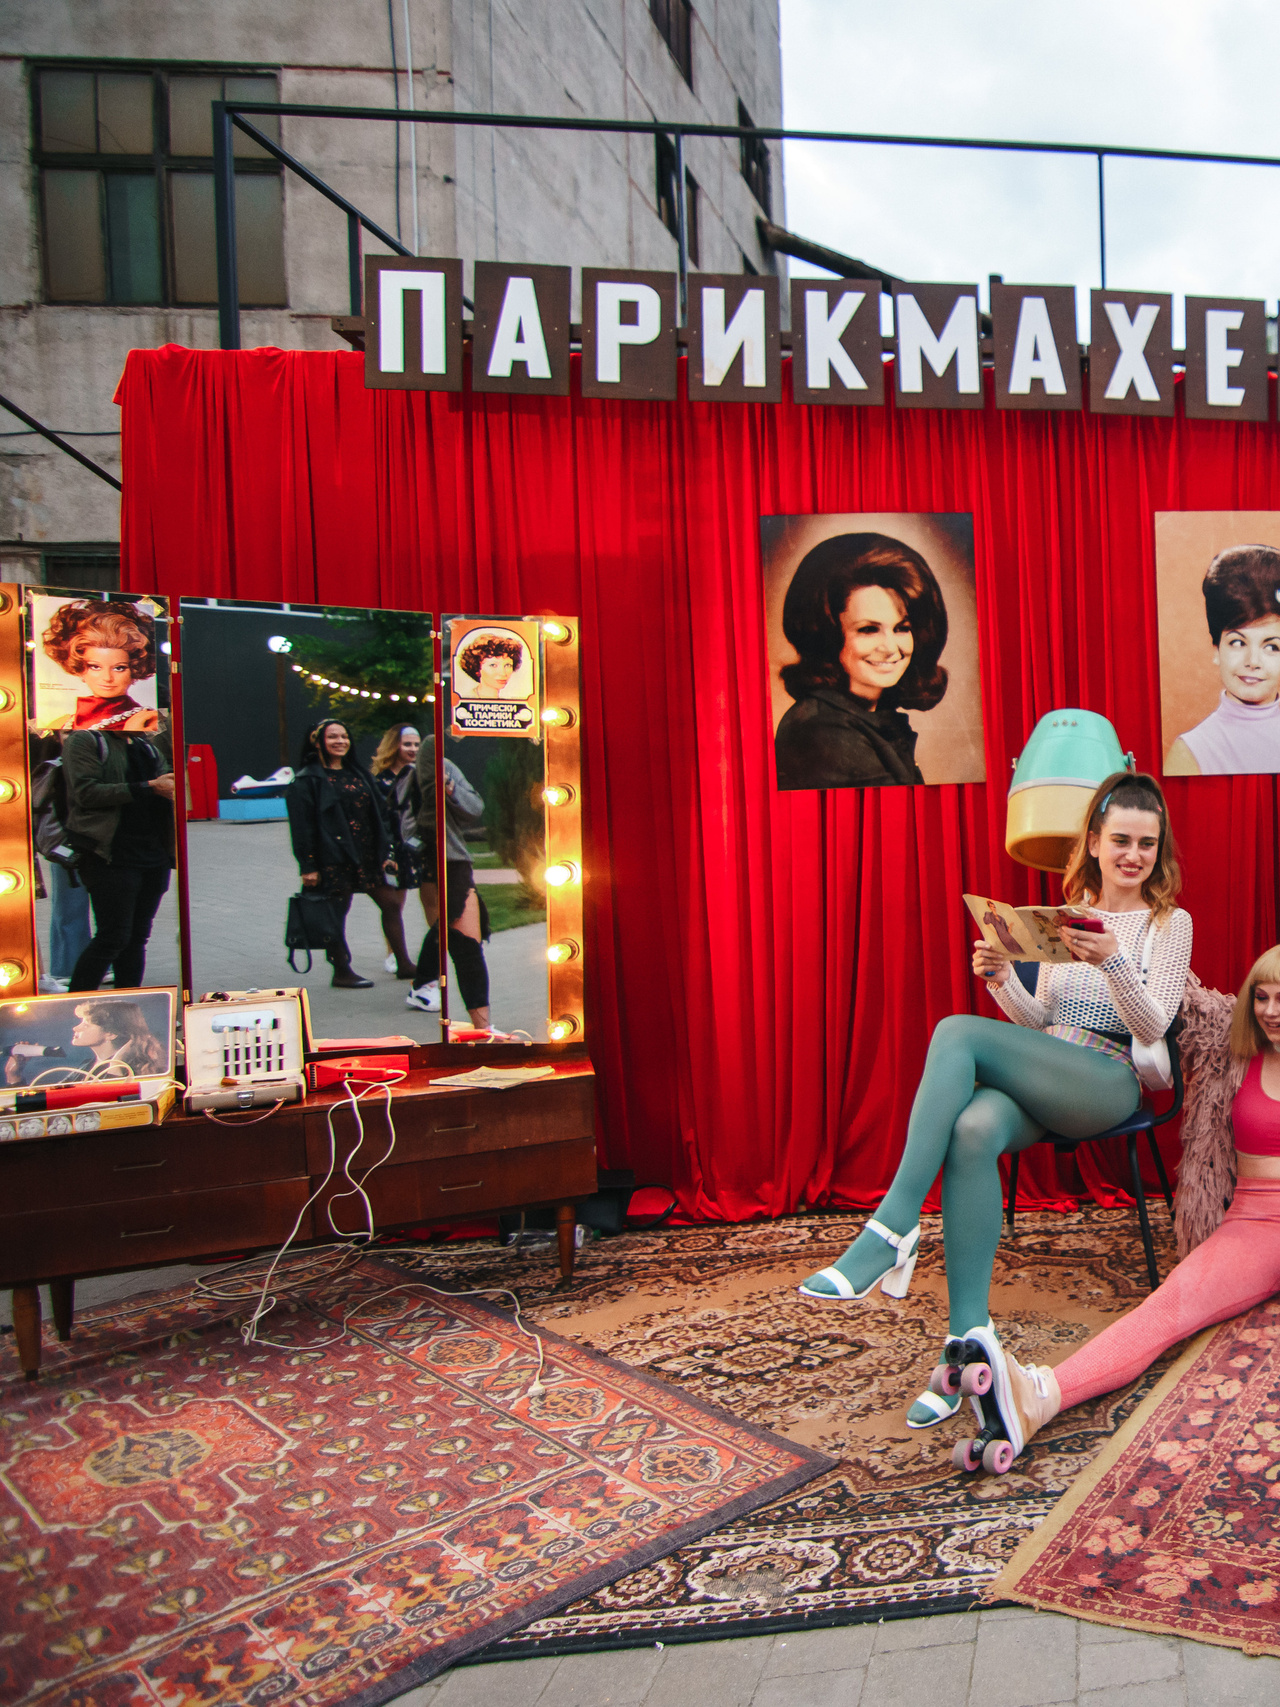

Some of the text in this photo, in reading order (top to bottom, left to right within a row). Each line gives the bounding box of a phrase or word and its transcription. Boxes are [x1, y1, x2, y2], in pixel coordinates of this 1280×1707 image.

[469, 704, 517, 712] ПРИЧЕСКИ
[474, 712, 512, 720] ПАРИКИ
[464, 719, 522, 728] КОСМЕТИКА
